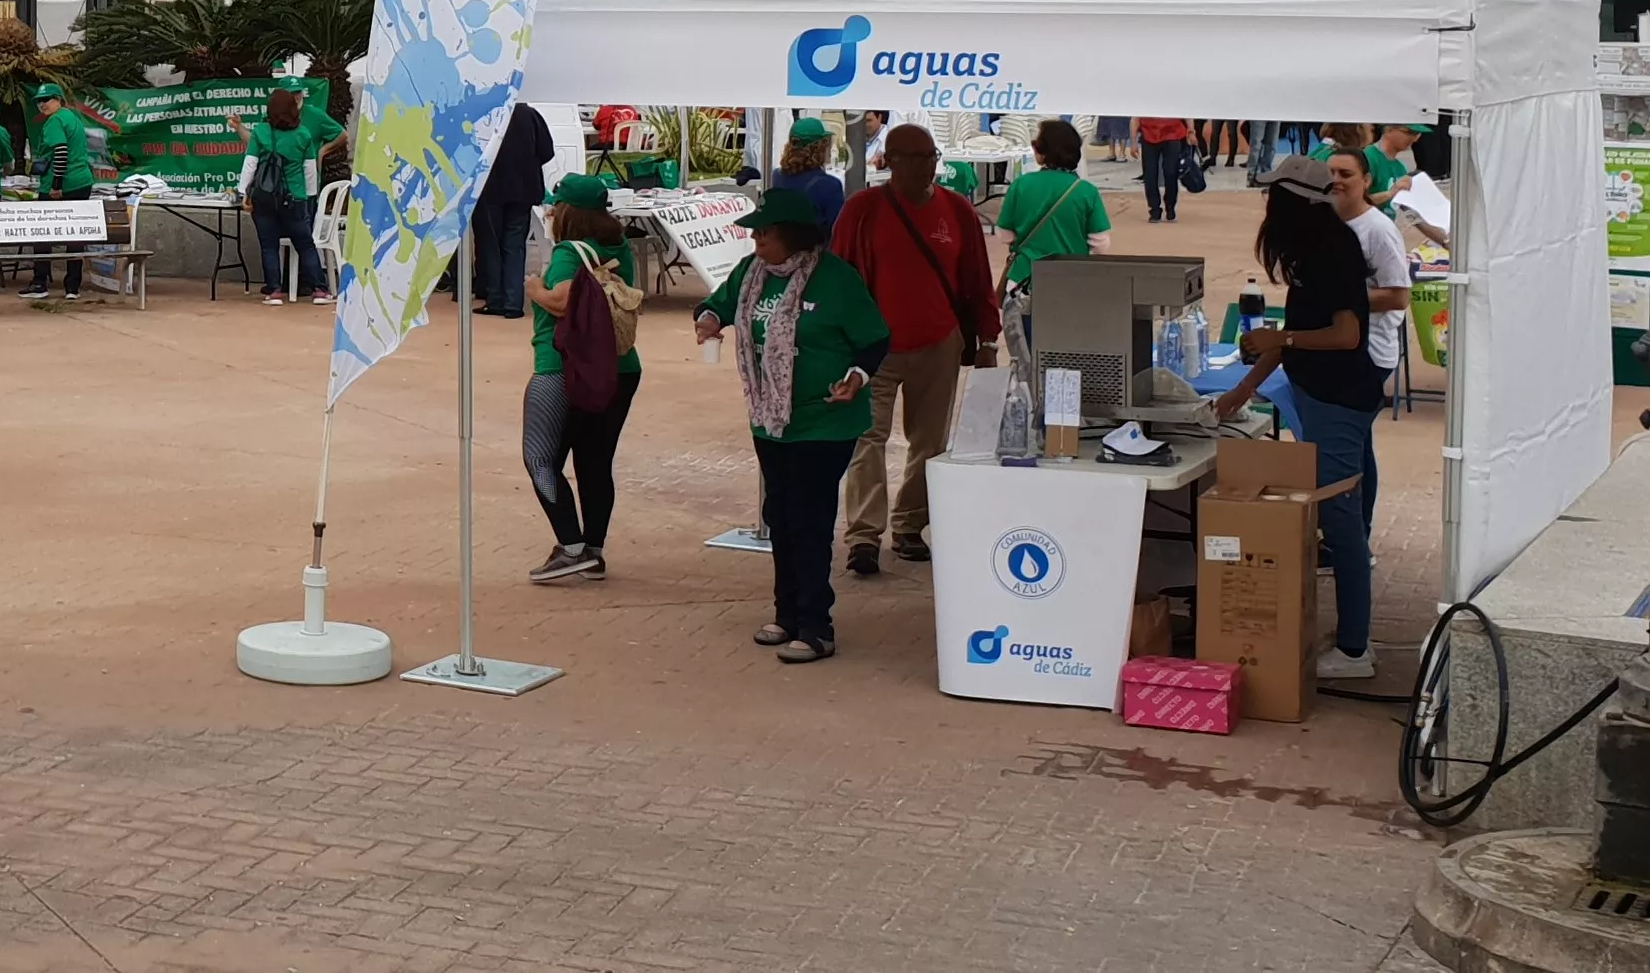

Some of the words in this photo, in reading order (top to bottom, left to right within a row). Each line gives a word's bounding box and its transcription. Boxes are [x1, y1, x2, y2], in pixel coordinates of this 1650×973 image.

[872, 50, 1000, 85] aguas
[136, 94, 172, 108] CAMPAÑA
[173, 92, 191, 104] POR
[206, 88, 251, 99] DERECHO
[254, 87, 267, 98] AL
[920, 81, 953, 109] de
[958, 81, 1038, 111] Cádiz
[126, 113, 144, 123] LAS
[144, 108, 192, 123] PERSONAS
[193, 104, 259, 117] EXTRANJERAS
[204, 172, 224, 183] Pro
[4, 227, 27, 237] HAZTE
[30, 227, 50, 236] SOCIA
[54, 226, 63, 236] DE
[66, 226, 75, 235] LA
[1411, 290, 1439, 302] SIN
[1000, 532, 1056, 555] COMUNIDAD
[1013, 582, 1047, 594] AZUL
[1009, 642, 1073, 661] aguas
[1033, 659, 1050, 674] de
[1053, 661, 1092, 677] Cádiz
